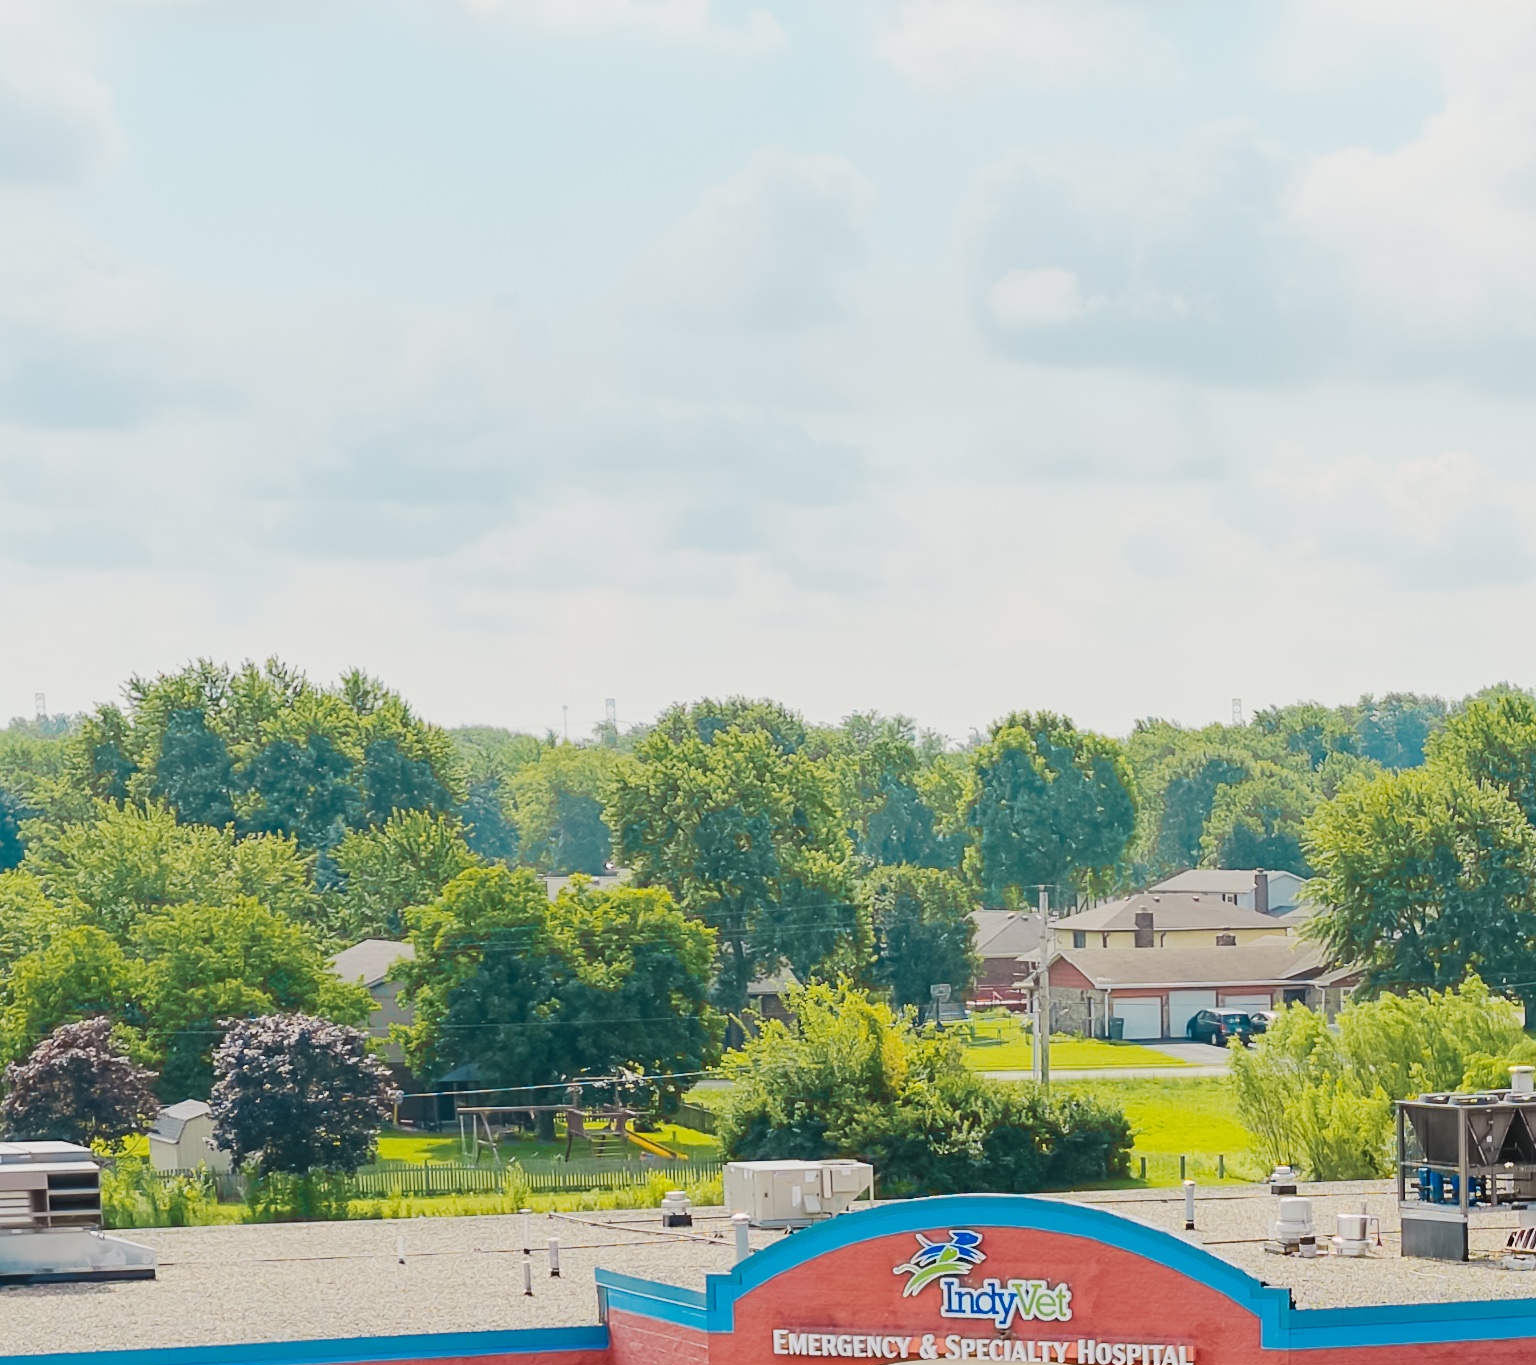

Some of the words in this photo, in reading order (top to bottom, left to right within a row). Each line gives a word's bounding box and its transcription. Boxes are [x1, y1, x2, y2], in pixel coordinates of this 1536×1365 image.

[944, 1281, 1067, 1325] IndyVet
[772, 1328, 912, 1359] EMERGENCY
[919, 1333, 939, 1360] &
[944, 1334, 1070, 1364] SPECIALTY
